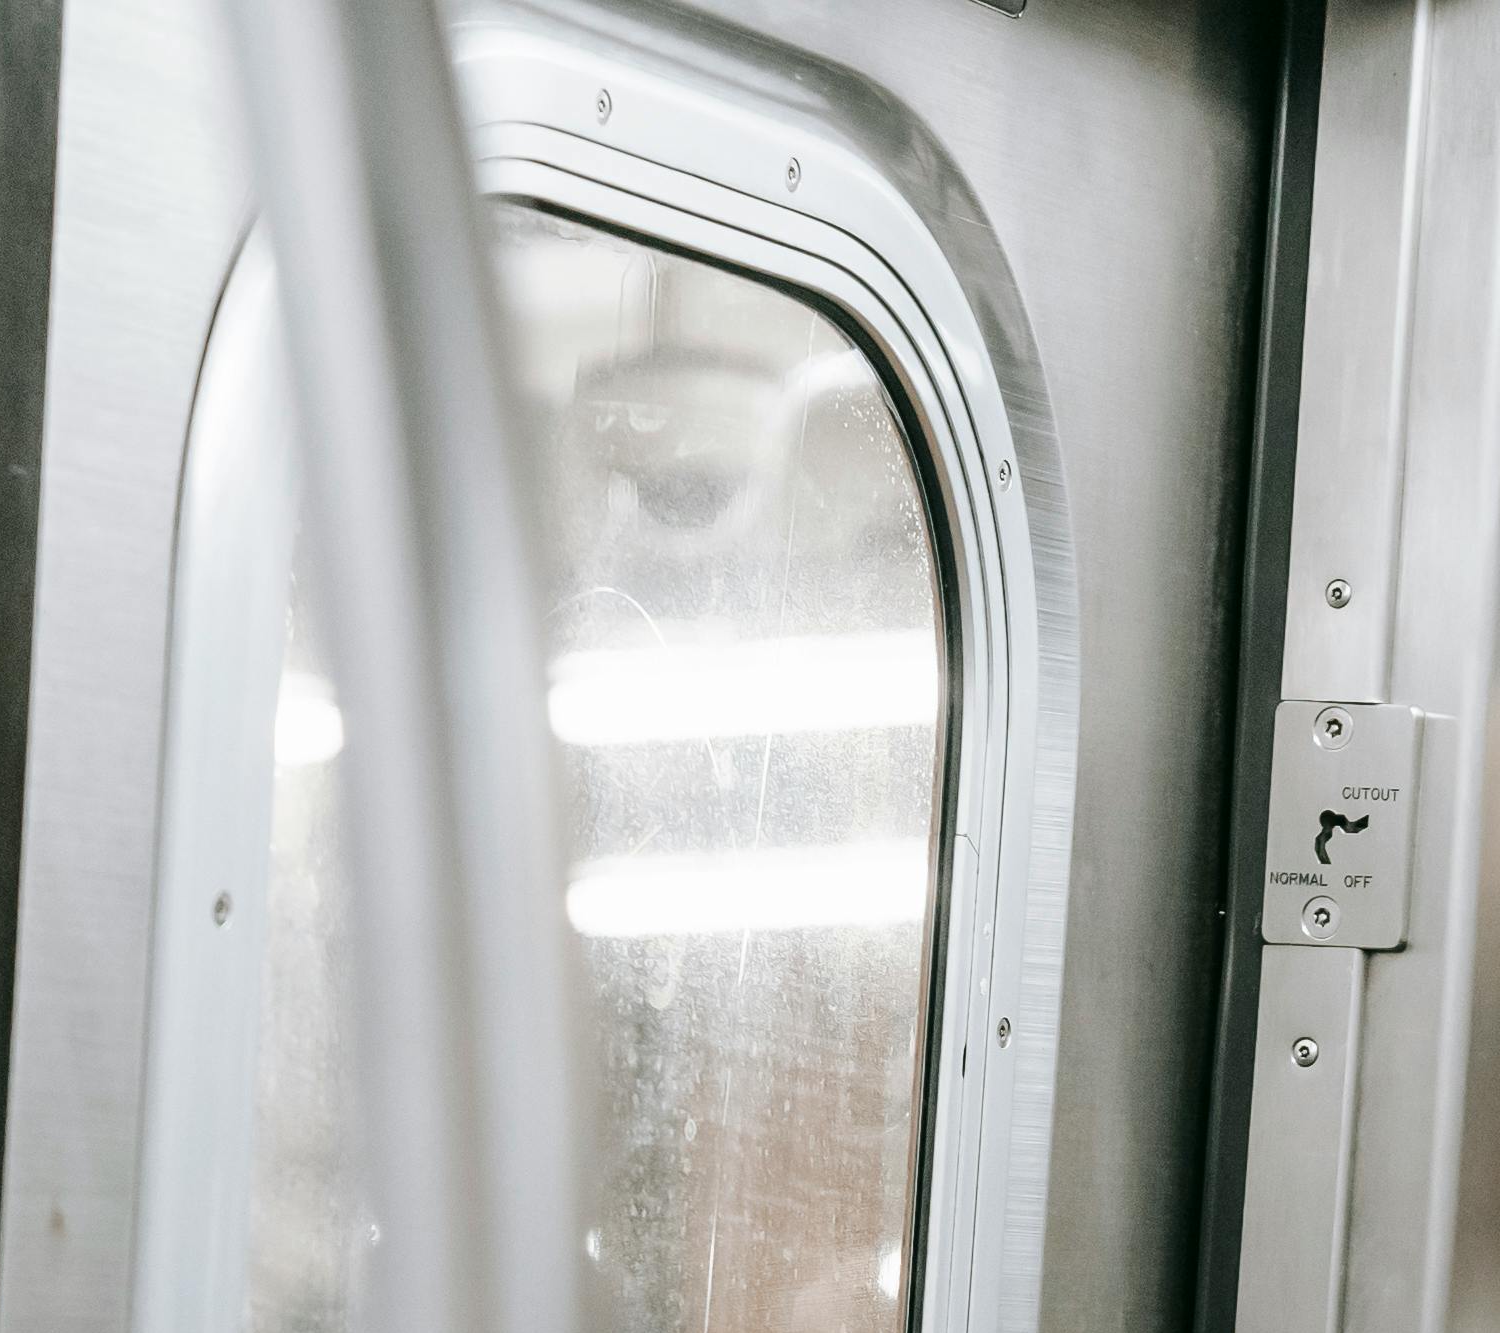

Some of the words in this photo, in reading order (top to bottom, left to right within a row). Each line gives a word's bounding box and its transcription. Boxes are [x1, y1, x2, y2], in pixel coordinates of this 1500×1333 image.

[1342, 787, 1399, 801] CUTOUT
[1270, 872, 1328, 887] NORMAL
[1344, 875, 1372, 888] OFF
